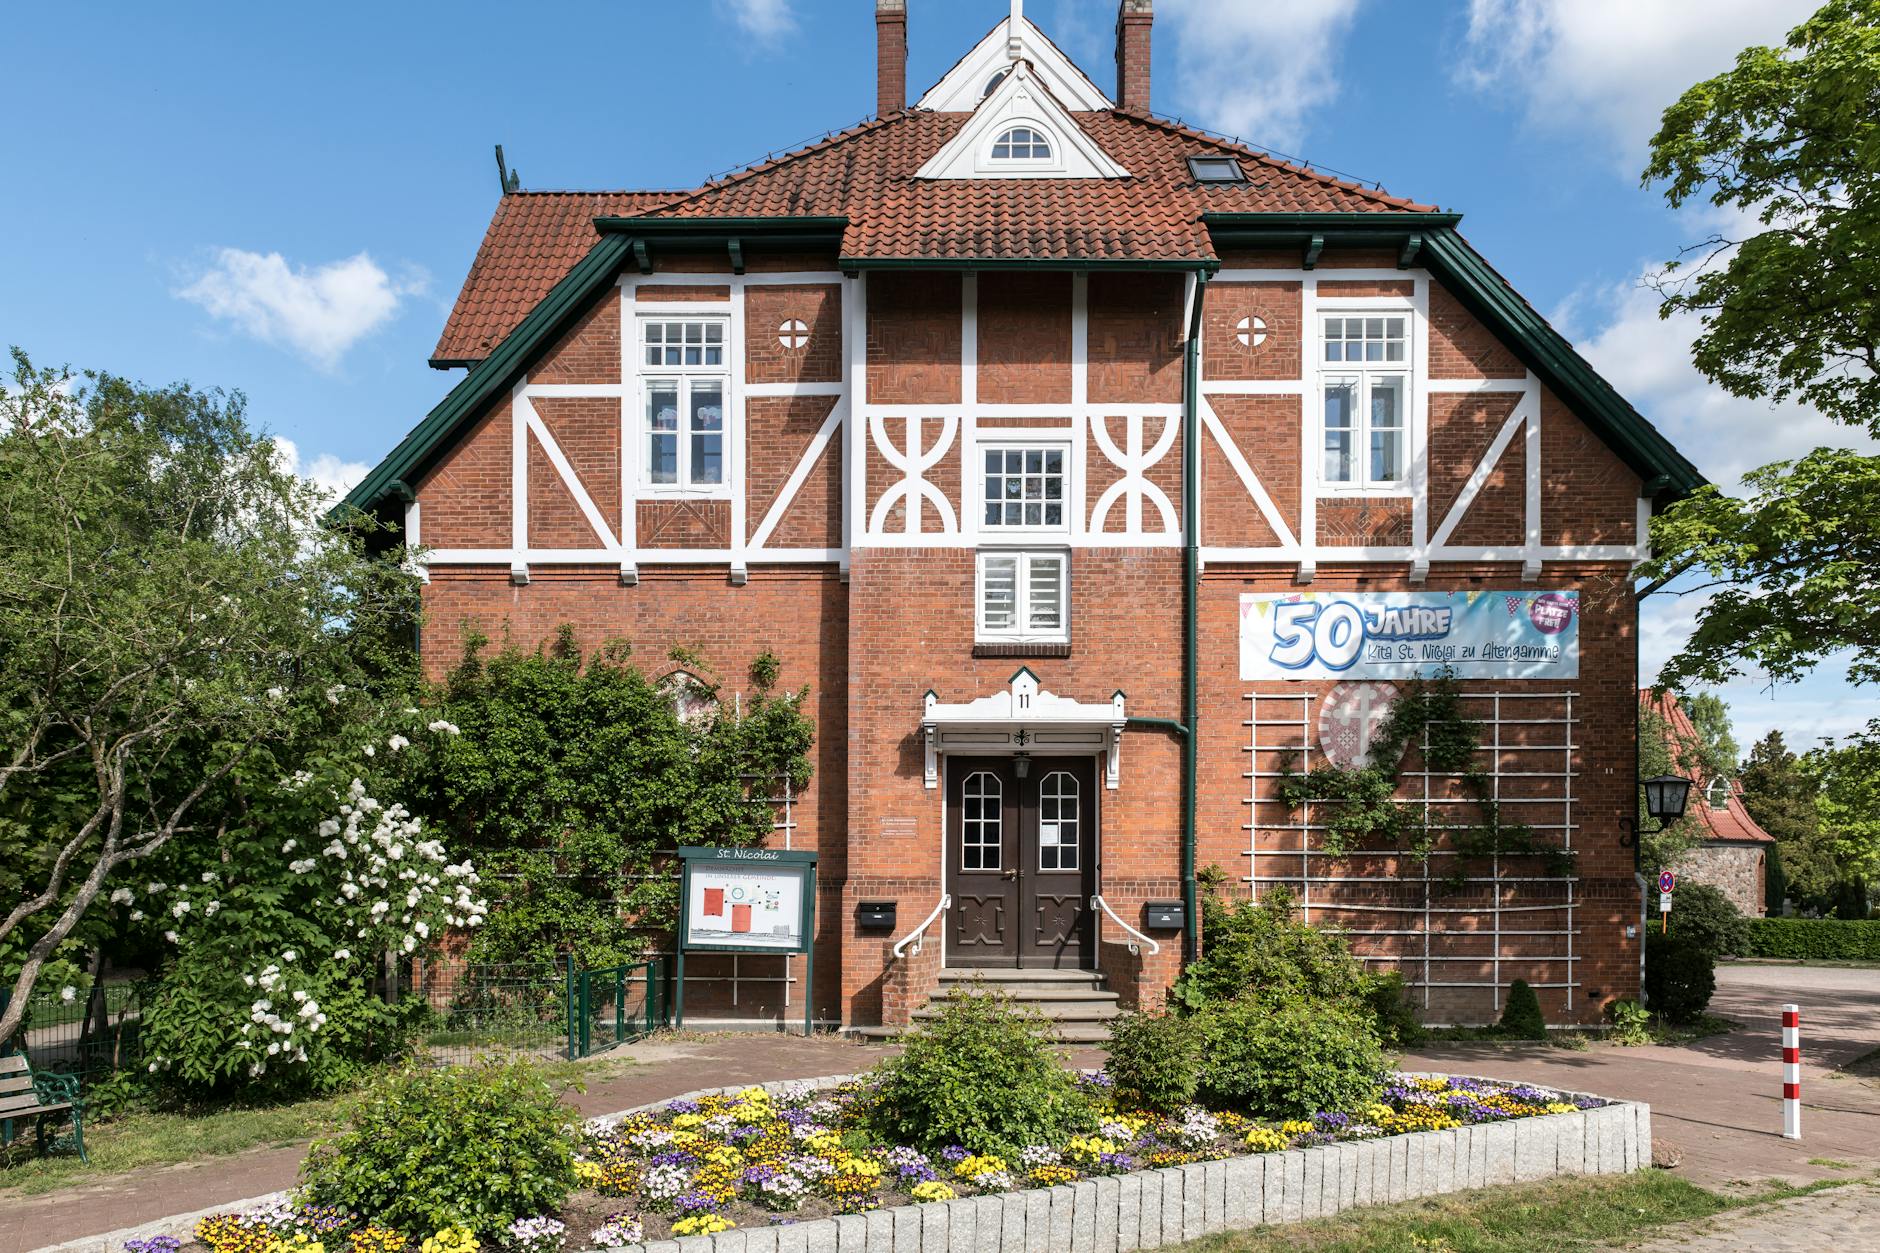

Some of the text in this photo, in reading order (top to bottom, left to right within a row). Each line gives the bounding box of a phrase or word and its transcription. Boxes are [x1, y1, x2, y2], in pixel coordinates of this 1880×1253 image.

[1269, 601, 1452, 671] 50 JAHRE
[1367, 641, 1560, 661] Kita St. Nicolai zu Altengamme
[1019, 694, 1029, 709] 11
[717, 848, 779, 860] St. Nicolai
